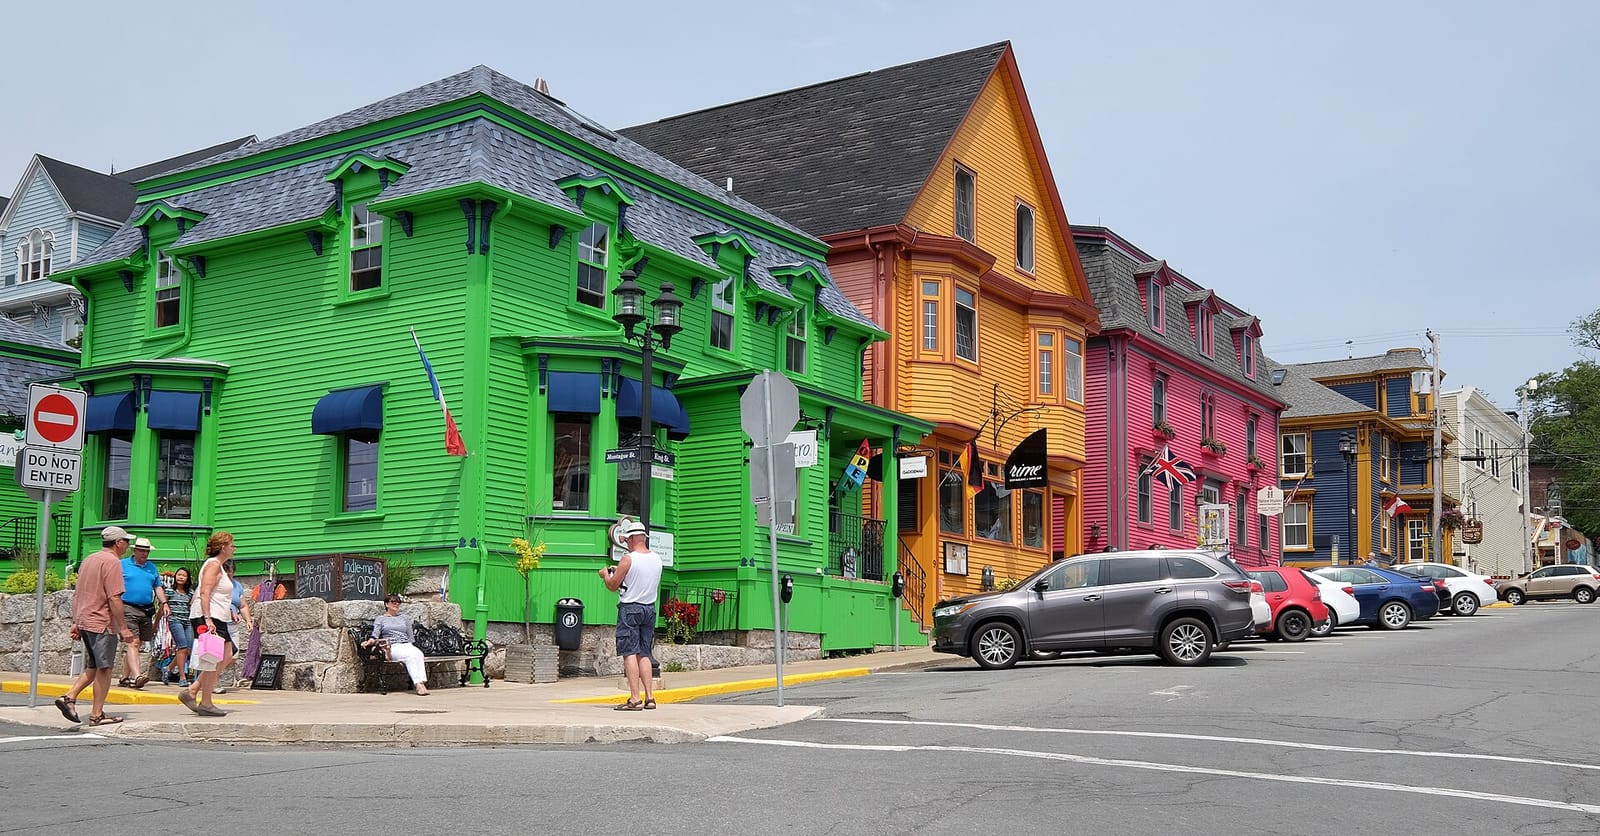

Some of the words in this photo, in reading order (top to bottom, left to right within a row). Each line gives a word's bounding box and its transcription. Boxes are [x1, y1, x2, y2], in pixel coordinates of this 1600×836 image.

[29, 455, 47, 467] DO
[51, 457, 77, 470] NOT
[654, 453, 664, 463] King
[844, 446, 869, 490] OPEN
[1009, 463, 1042, 478] rime
[30, 470, 73, 485] ENTER
[298, 561, 329, 576] indie-me
[344, 560, 374, 574] indie-me
[309, 572, 331, 593] OPEN
[357, 575, 384, 595] OPEN
